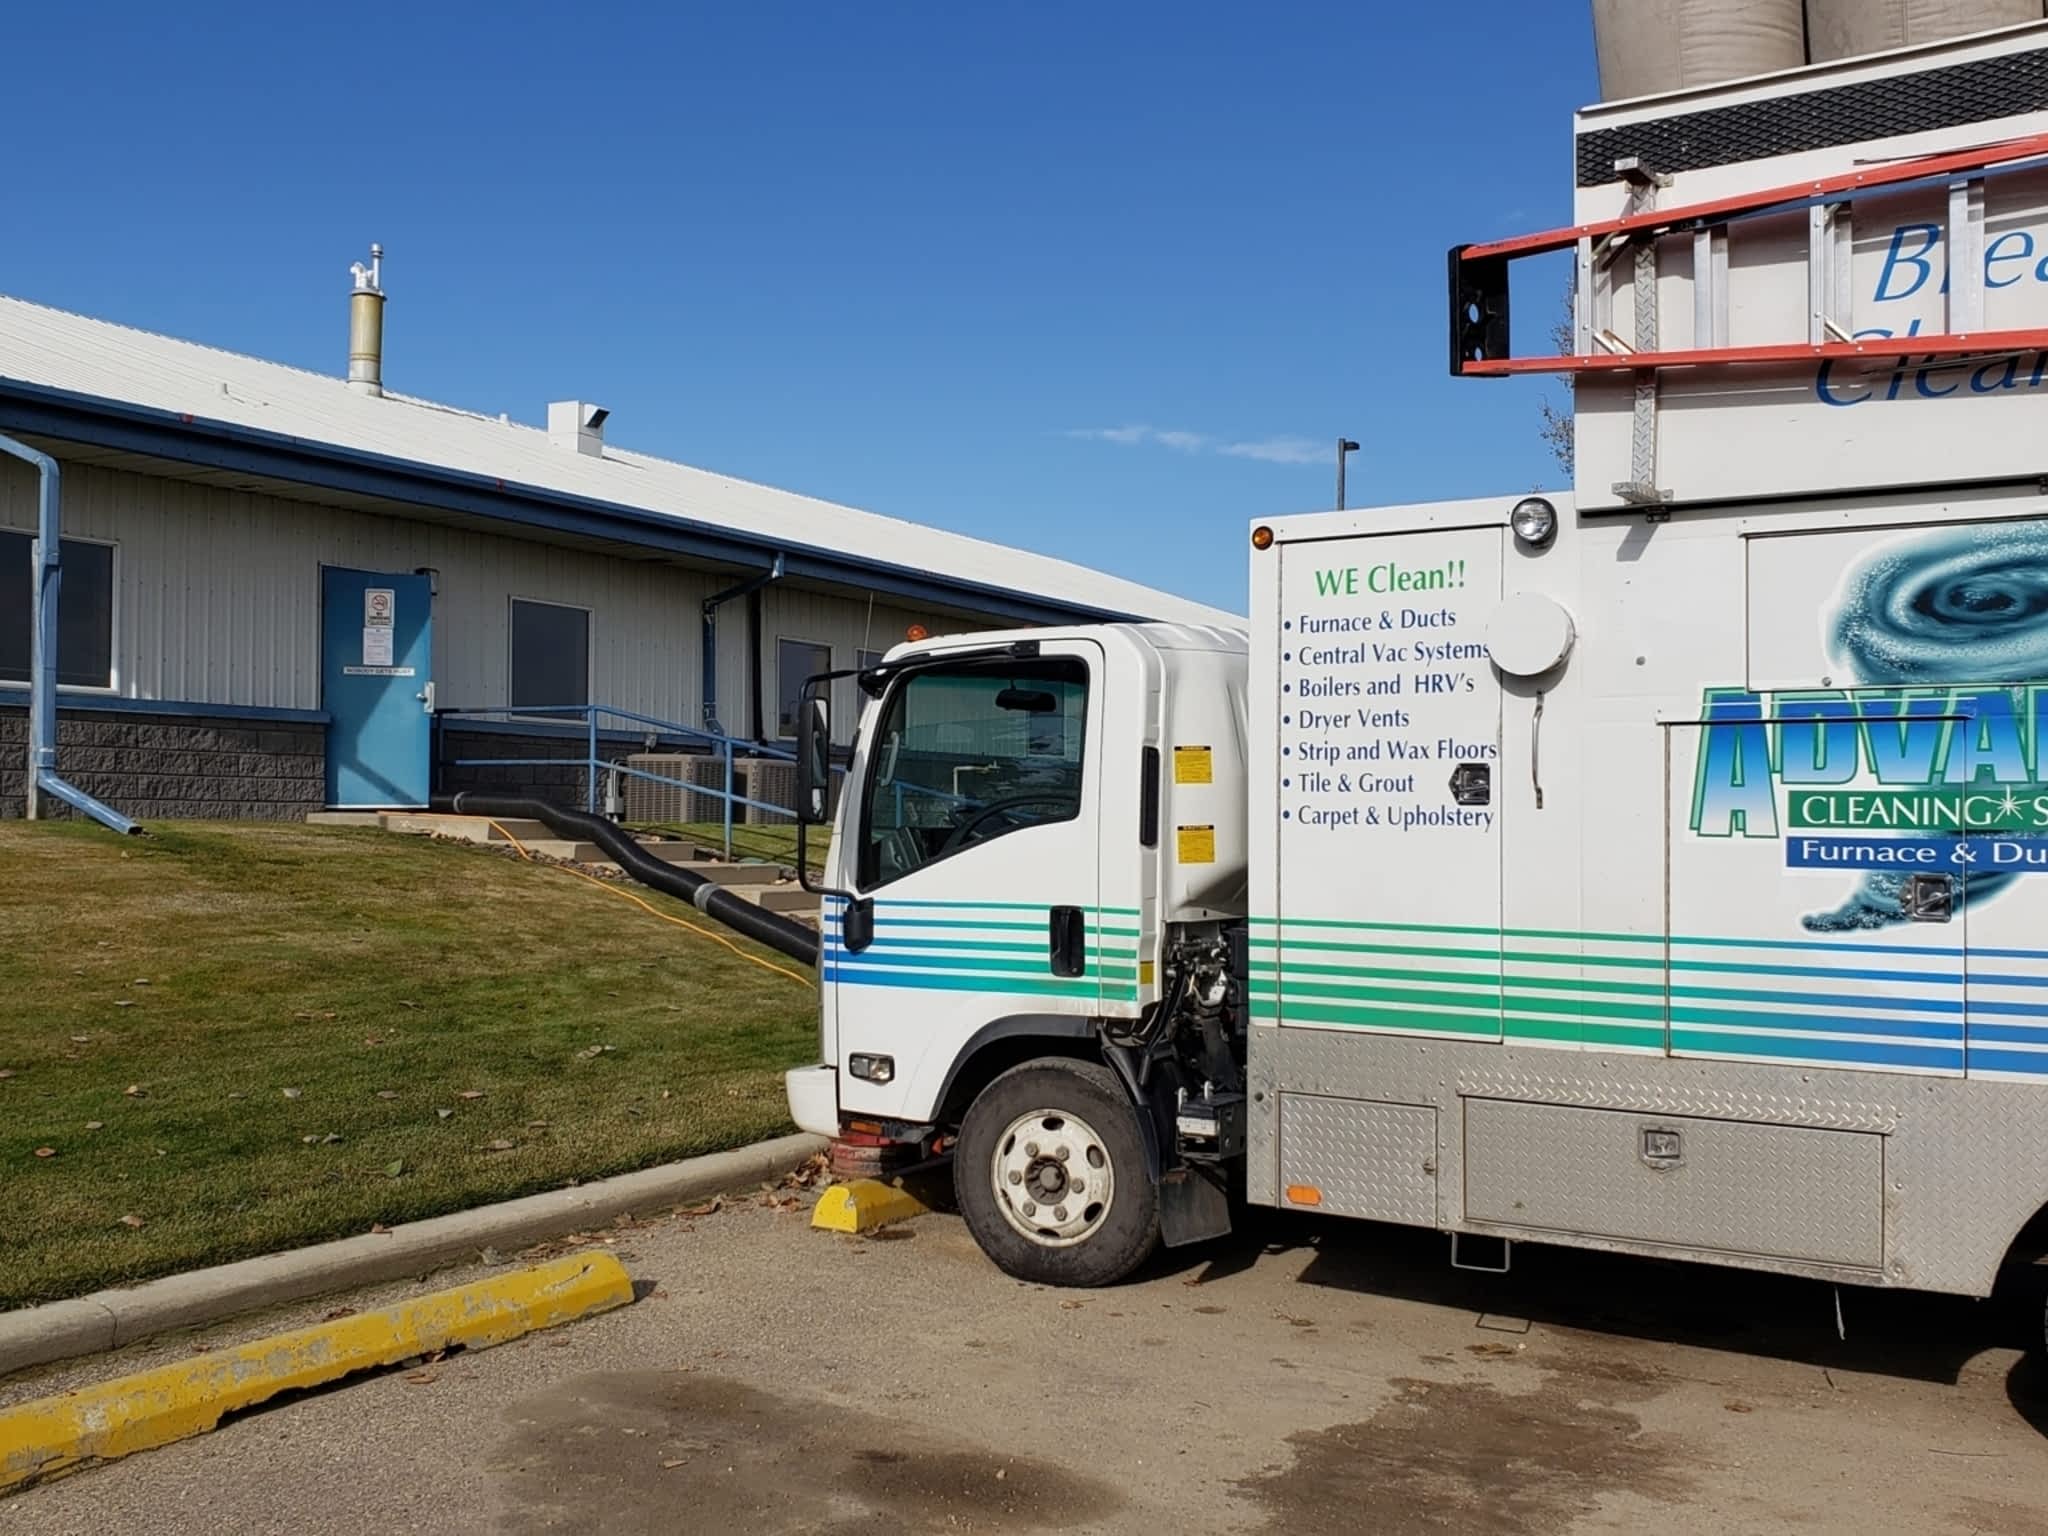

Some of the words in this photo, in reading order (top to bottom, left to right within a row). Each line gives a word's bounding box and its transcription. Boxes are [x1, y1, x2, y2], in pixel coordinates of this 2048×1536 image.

[1315, 568, 1359, 597] WE
[1368, 560, 1465, 594] Clean!!
[1300, 613, 1372, 634] Furnace
[1378, 611, 1393, 629] &
[1401, 608, 1456, 629] Ducts
[1299, 643, 1365, 666] Central
[1372, 644, 1408, 662] Vac
[1414, 641, 1489, 667] Systems
[1300, 676, 1360, 697] Boilers
[1367, 674, 1400, 695] and
[1415, 672, 1475, 693] HRV's
[1300, 710, 1351, 735] Dryer
[1357, 709, 1410, 728] Vents
[1298, 740, 1341, 766] Strip
[1347, 739, 1380, 760] and
[1387, 740, 1430, 760] Wax
[1437, 738, 1497, 760] Floors
[1690, 687, 2048, 839] ADVA
[1299, 772, 1331, 793] Tile
[1338, 773, 1352, 792] &
[1359, 773, 1414, 793] Grout
[1298, 805, 1359, 831] Carpet
[1366, 806, 1380, 825] &
[1388, 806, 1494, 833] Upholstery
[1801, 796, 1993, 826] CLEANING
[1802, 840, 1937, 863] Furnace
[1950, 842, 1977, 864] &
